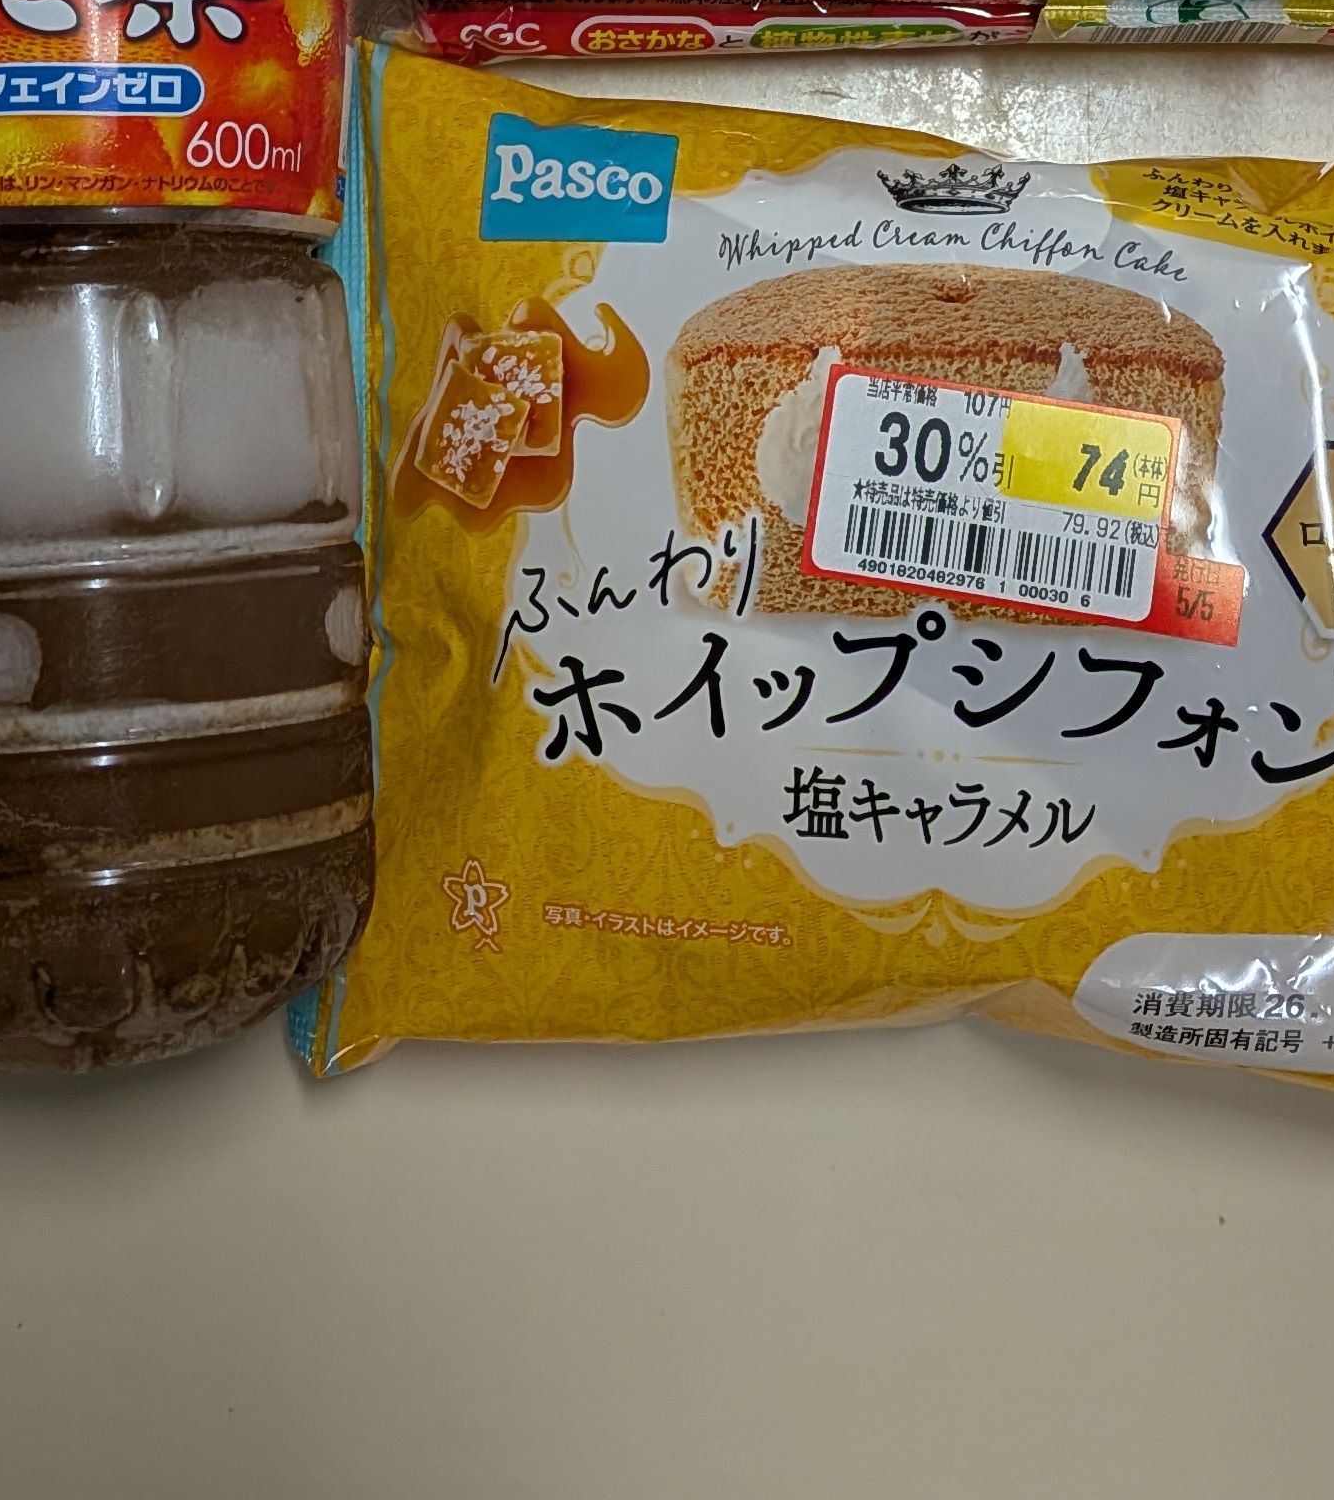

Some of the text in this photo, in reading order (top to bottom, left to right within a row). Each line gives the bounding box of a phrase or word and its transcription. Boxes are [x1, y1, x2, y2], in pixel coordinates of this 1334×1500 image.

[586, 29, 706, 51] おさかな
[185, 120, 303, 173] 600ml
[489, 144, 664, 205] Pasco
[718, 219, 1188, 283] Whipped Cream Chiffon Cake
[874, 410, 1015, 490] 30%引
[1072, 443, 1128, 497] 74
[1062, 510, 1122, 541] 79.92
[857, 557, 986, 592] 4901820482976
[1017, 582, 1069, 606] 00030
[1175, 585, 1216, 622] 5/5
[782, 765, 1097, 850] 塩キャラメル
[544, 904, 792, 946] 写真・イラストはイメージです。
[1130, 1021, 1304, 1054] 製造所固有記号
